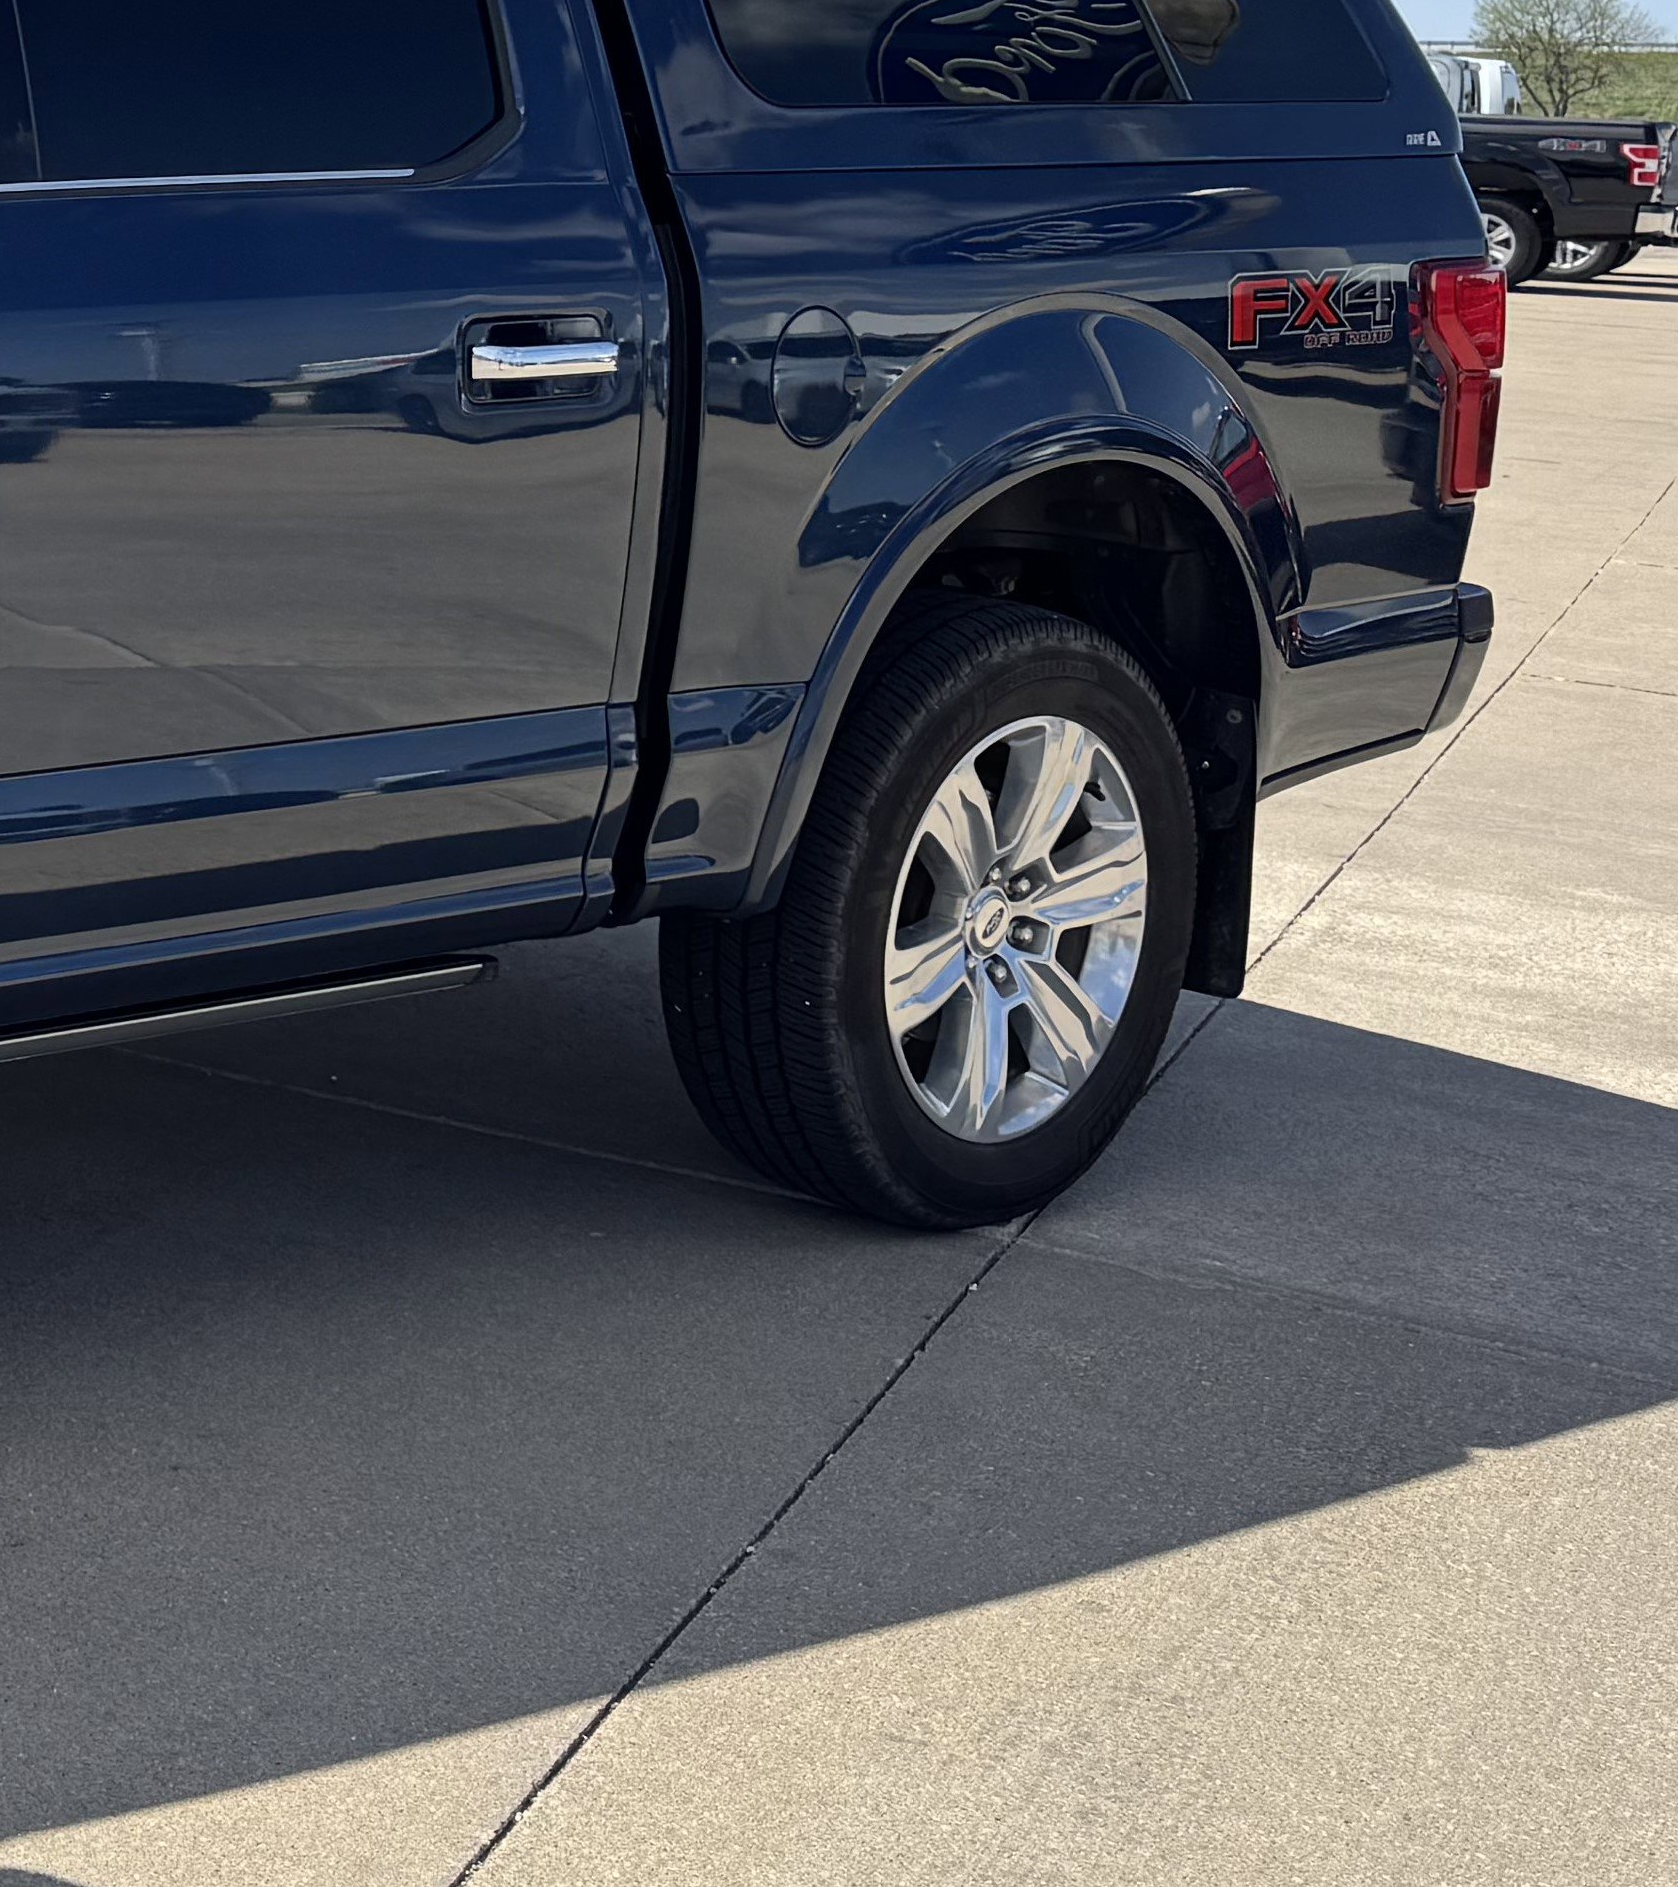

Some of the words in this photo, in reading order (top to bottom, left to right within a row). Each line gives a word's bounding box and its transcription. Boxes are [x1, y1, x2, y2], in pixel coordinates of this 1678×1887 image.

[1227, 263, 1396, 351] FX4
[1303, 332, 1340, 348] OFF
[1345, 329, 1394, 345] ROAD
